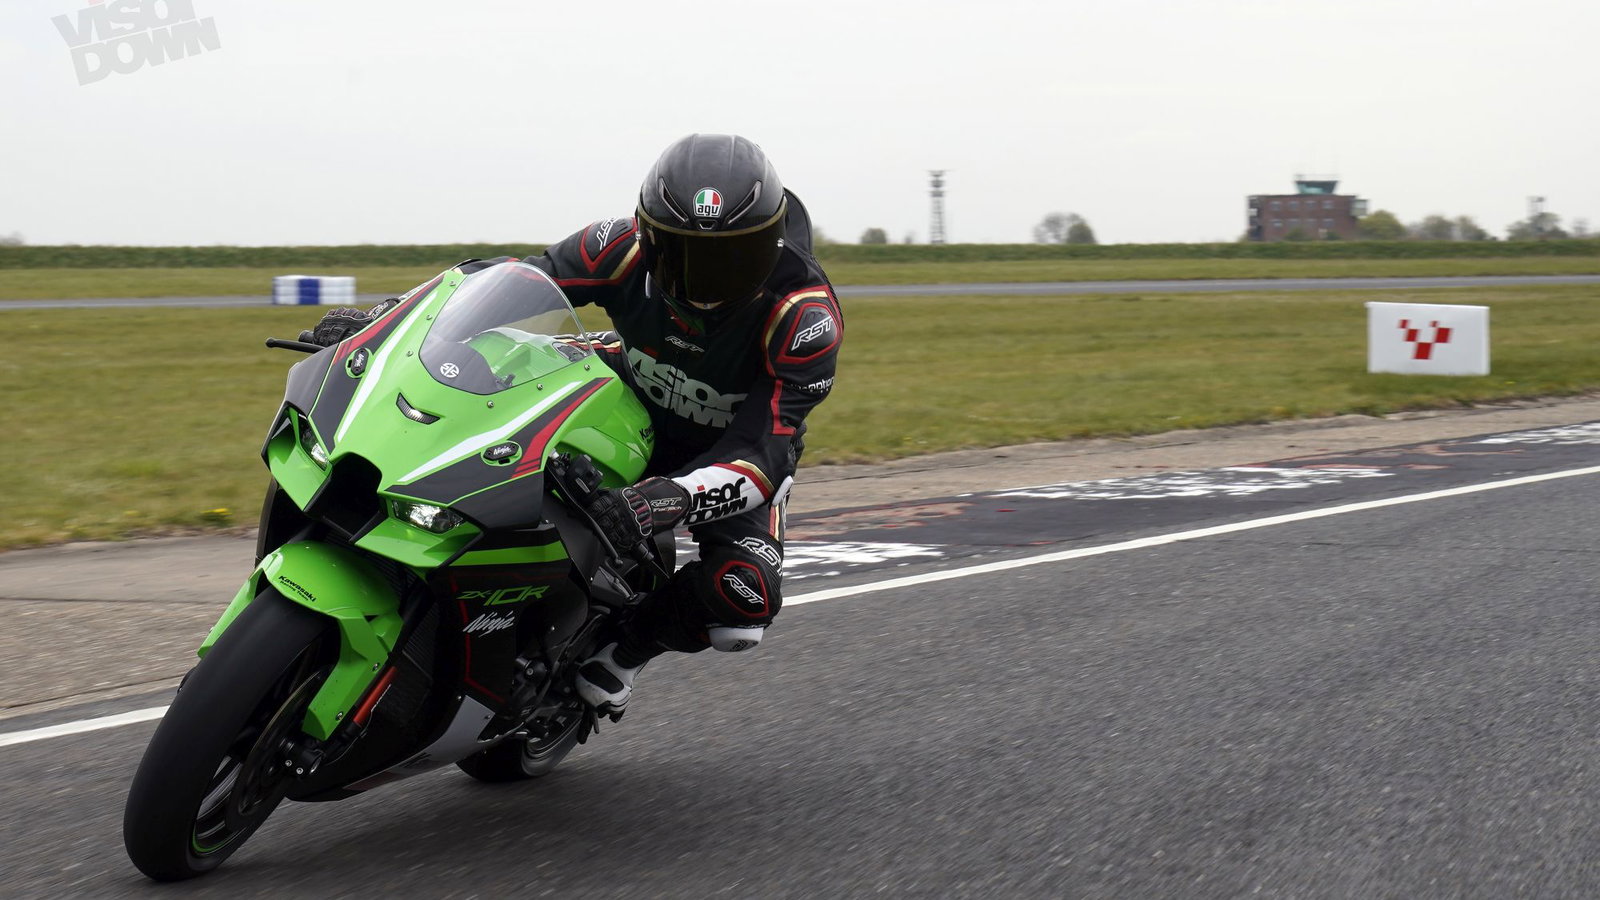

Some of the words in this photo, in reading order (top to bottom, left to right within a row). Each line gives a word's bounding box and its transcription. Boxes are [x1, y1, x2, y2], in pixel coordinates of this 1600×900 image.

[697, 204, 719, 216] agv
[664, 335, 705, 353] RST
[791, 315, 834, 351] RST
[650, 496, 682, 508] RST
[278, 575, 317, 602] Kawasaki
[723, 573, 765, 605] RST
[462, 610, 515, 638] Ninja
